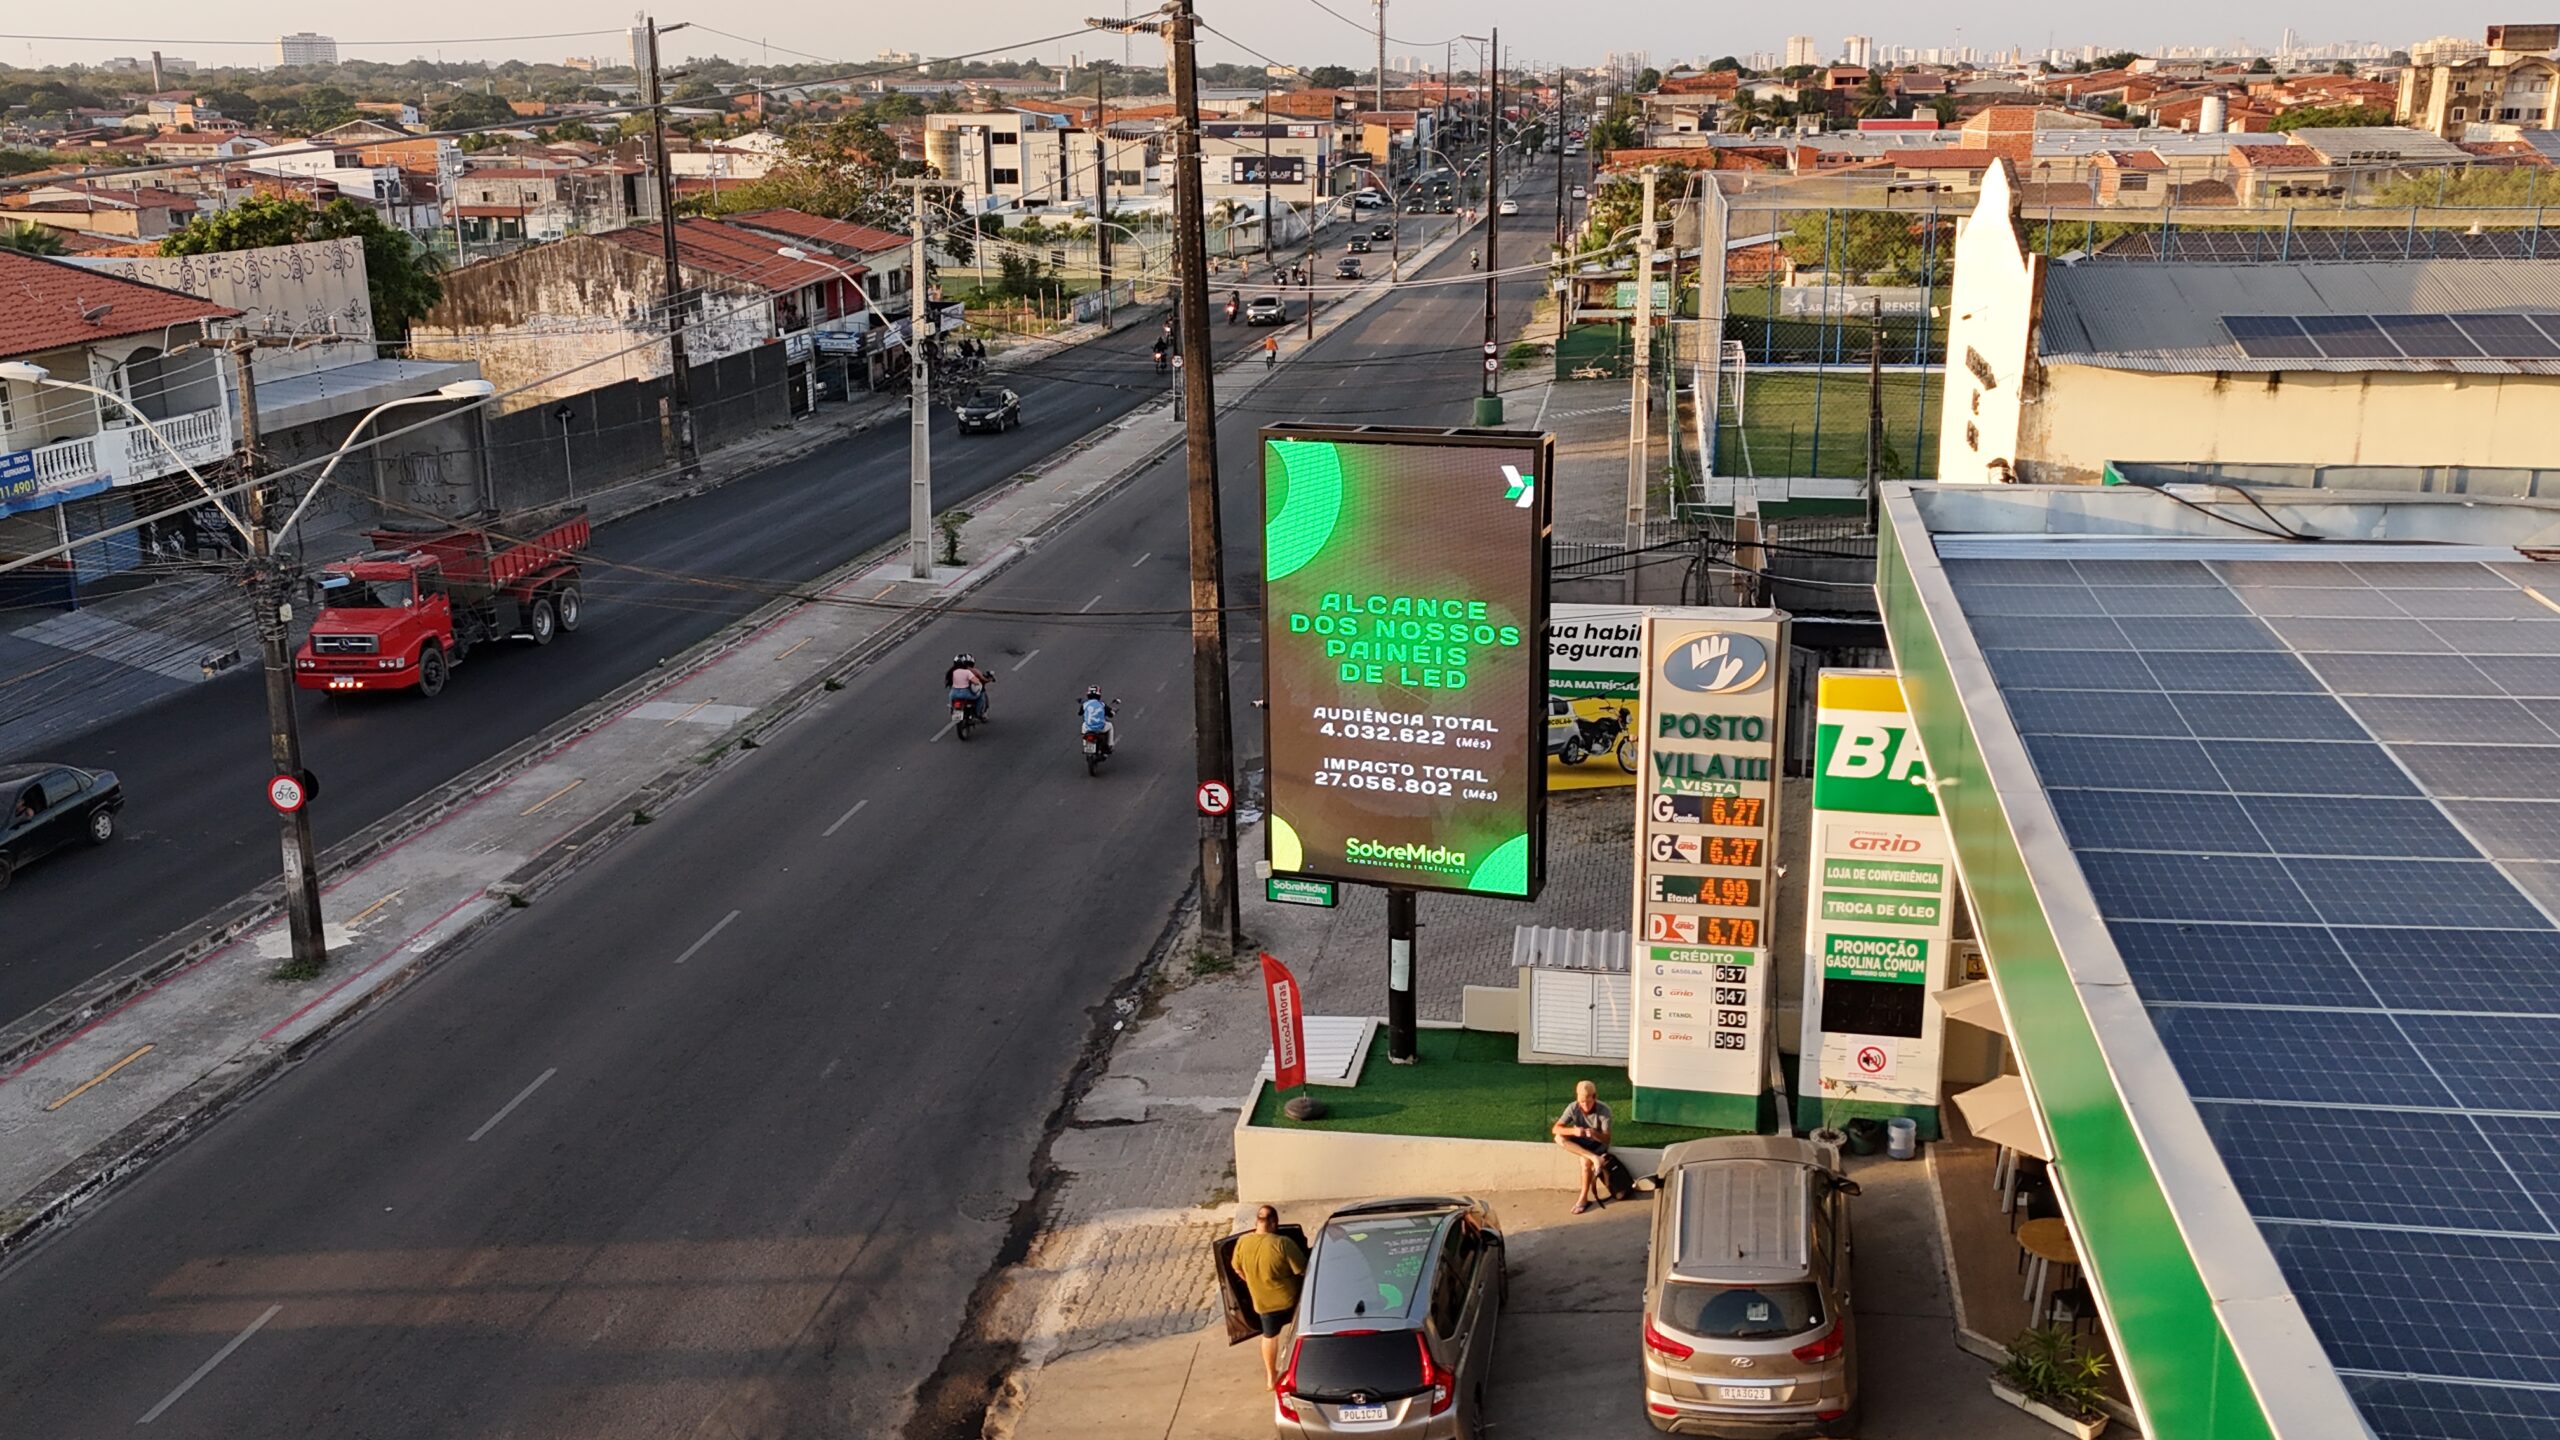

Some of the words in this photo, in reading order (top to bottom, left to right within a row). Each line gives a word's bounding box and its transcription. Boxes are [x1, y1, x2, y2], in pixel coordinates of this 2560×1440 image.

[1861, 301, 1922, 312] CERENSE
[1321, 593, 1488, 621] ALCANCE
[1290, 613, 1358, 637] DOS
[1375, 619, 1520, 647] NOSSOS
[1583, 623, 1641, 642] habil
[1326, 639, 1467, 667] PAINÉIS
[1548, 642, 1641, 661] seguran
[1341, 663, 1383, 685] DE
[1400, 667, 1467, 690] LED
[1549, 679, 1573, 689] SUA
[1313, 706, 1424, 726] AUDIÊNCIA
[1432, 715, 1499, 733] TOTAL
[1659, 711, 1764, 742] POSTO
[1320, 723, 1445, 745] 4.032.622
[1456, 737, 1492, 751] (Mês)
[1323, 757, 1414, 777] IMPACTO
[1423, 765, 1489, 783] TOTAL
[1653, 750, 1727, 780] VILA
[1733, 755, 1769, 781] III
[1314, 771, 1452, 796] 27.056.802
[1680, 780, 1737, 794] VISTA
[1653, 794, 1674, 822] G
[1712, 797, 1760, 826] 6.27
[1652, 834, 1673, 862] G
[1709, 837, 1758, 866] 6.37
[1827, 866, 1852, 880] LOJA
[1853, 869, 1865, 881] DE
[1868, 868, 1938, 885] CONVENIÊNCIA
[1650, 875, 1664, 901] E
[1667, 892, 1697, 904] Etanol
[1701, 878, 1749, 906] 4.99
[1827, 900, 1873, 915] TROCA
[1877, 904, 1895, 917] DE
[1898, 903, 1935, 918] ÓLEO
[1650, 913, 1667, 940] D
[1707, 918, 1755, 946] 5.79
[1670, 949, 1734, 964] CRÉDITO
[1834, 939, 1918, 958] PROMOÇÃO
[1655, 964, 1664, 976] G
[1671, 968, 1703, 976] GASOLINA
[1716, 967, 1746, 981] 637
[1826, 954, 1881, 970] GASOLINA
[1883, 957, 1925, 973] COMUM
[1653, 986, 1663, 997] G
[1716, 990, 1746, 1004] 647
[1278, 984, 1294, 1066] Banco24Horas
[1653, 1008, 1662, 1020] E
[1718, 1012, 1746, 1026] 509
[1652, 1030, 1662, 1041] D
[1715, 1034, 1745, 1048] 599
